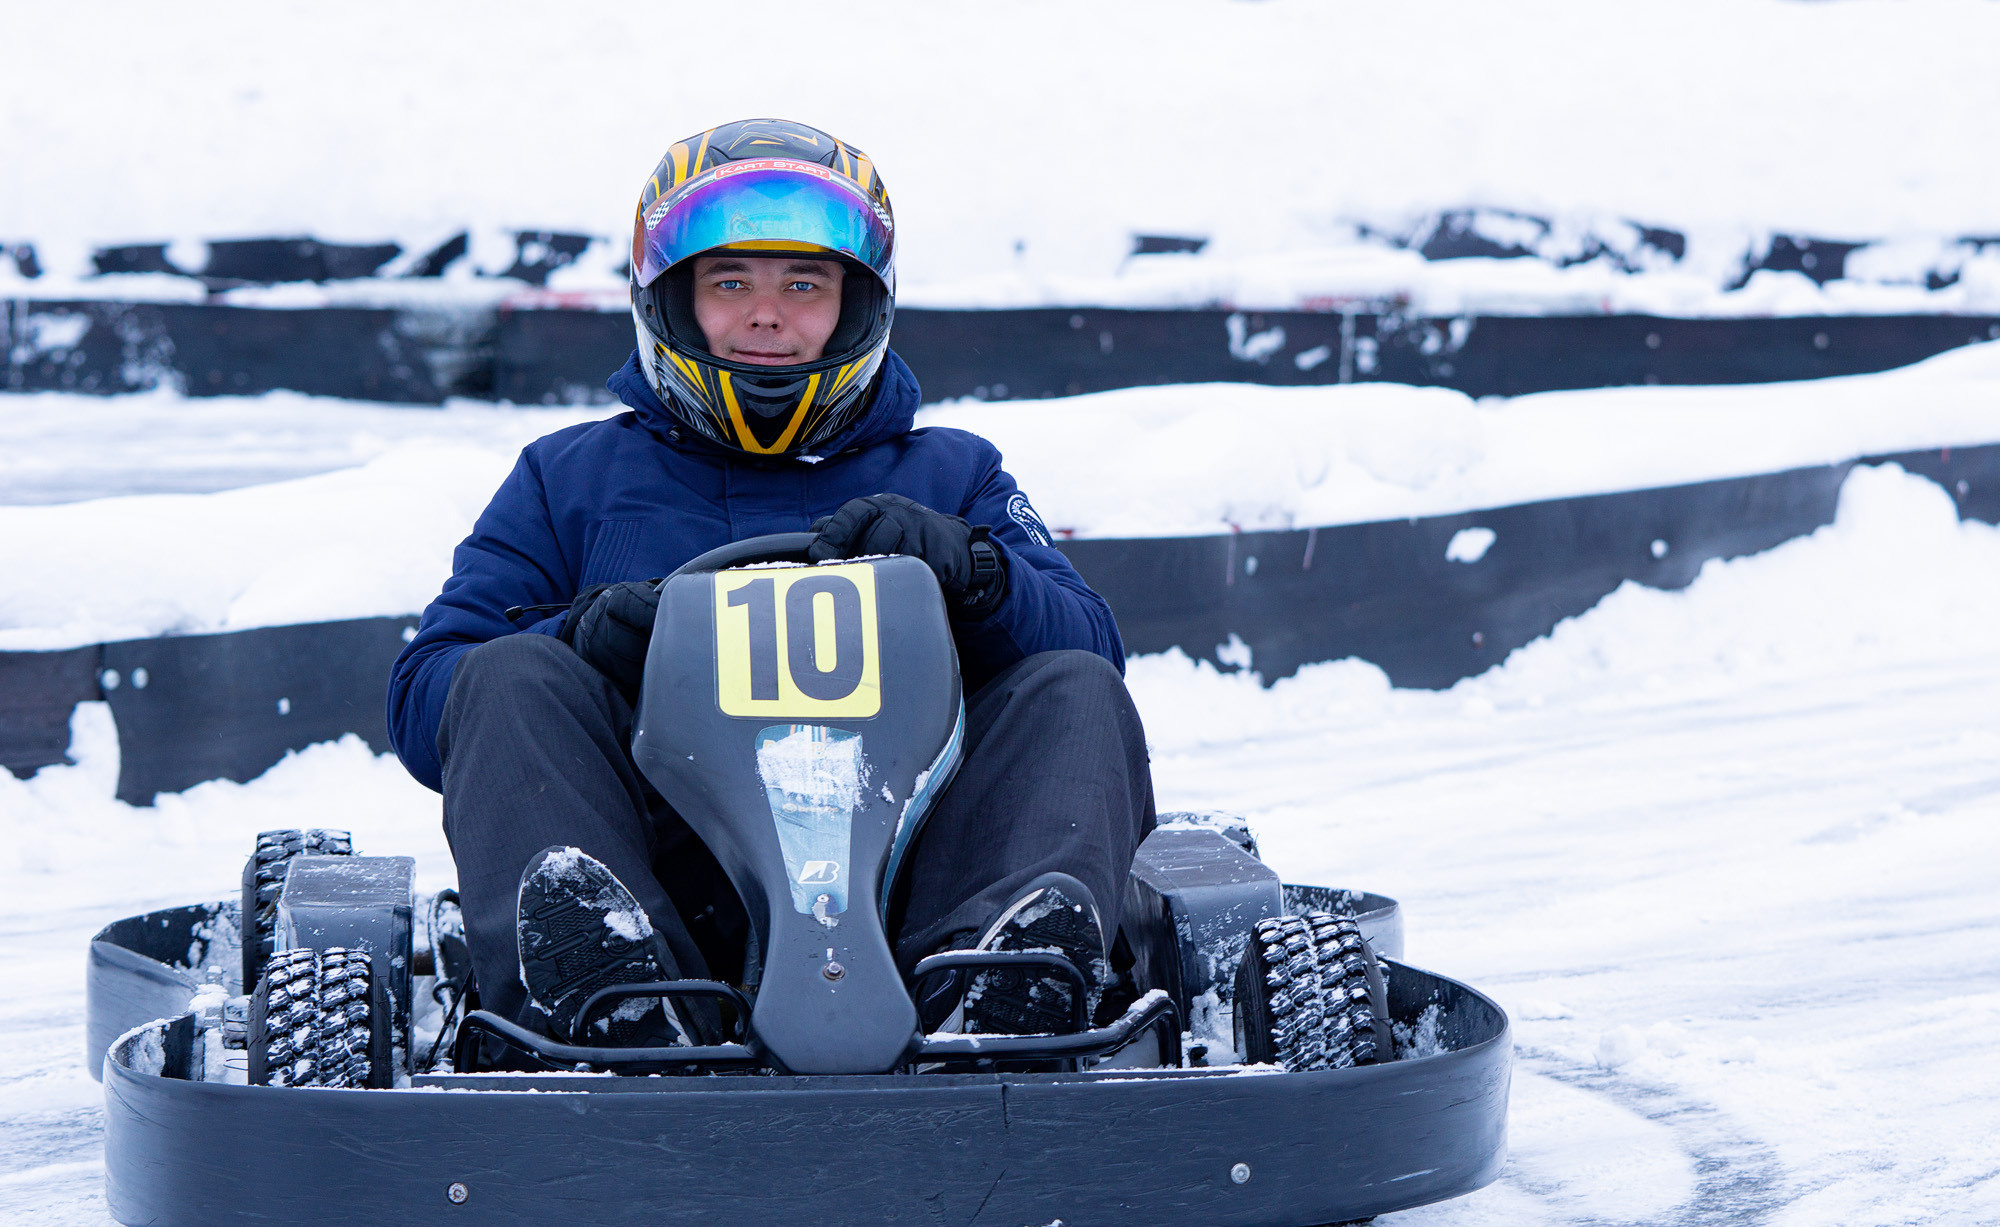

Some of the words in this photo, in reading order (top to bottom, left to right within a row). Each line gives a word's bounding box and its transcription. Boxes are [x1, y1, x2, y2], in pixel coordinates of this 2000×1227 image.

[720, 162, 766, 176] KART
[773, 161, 827, 176] START
[727, 575, 864, 701] 10
